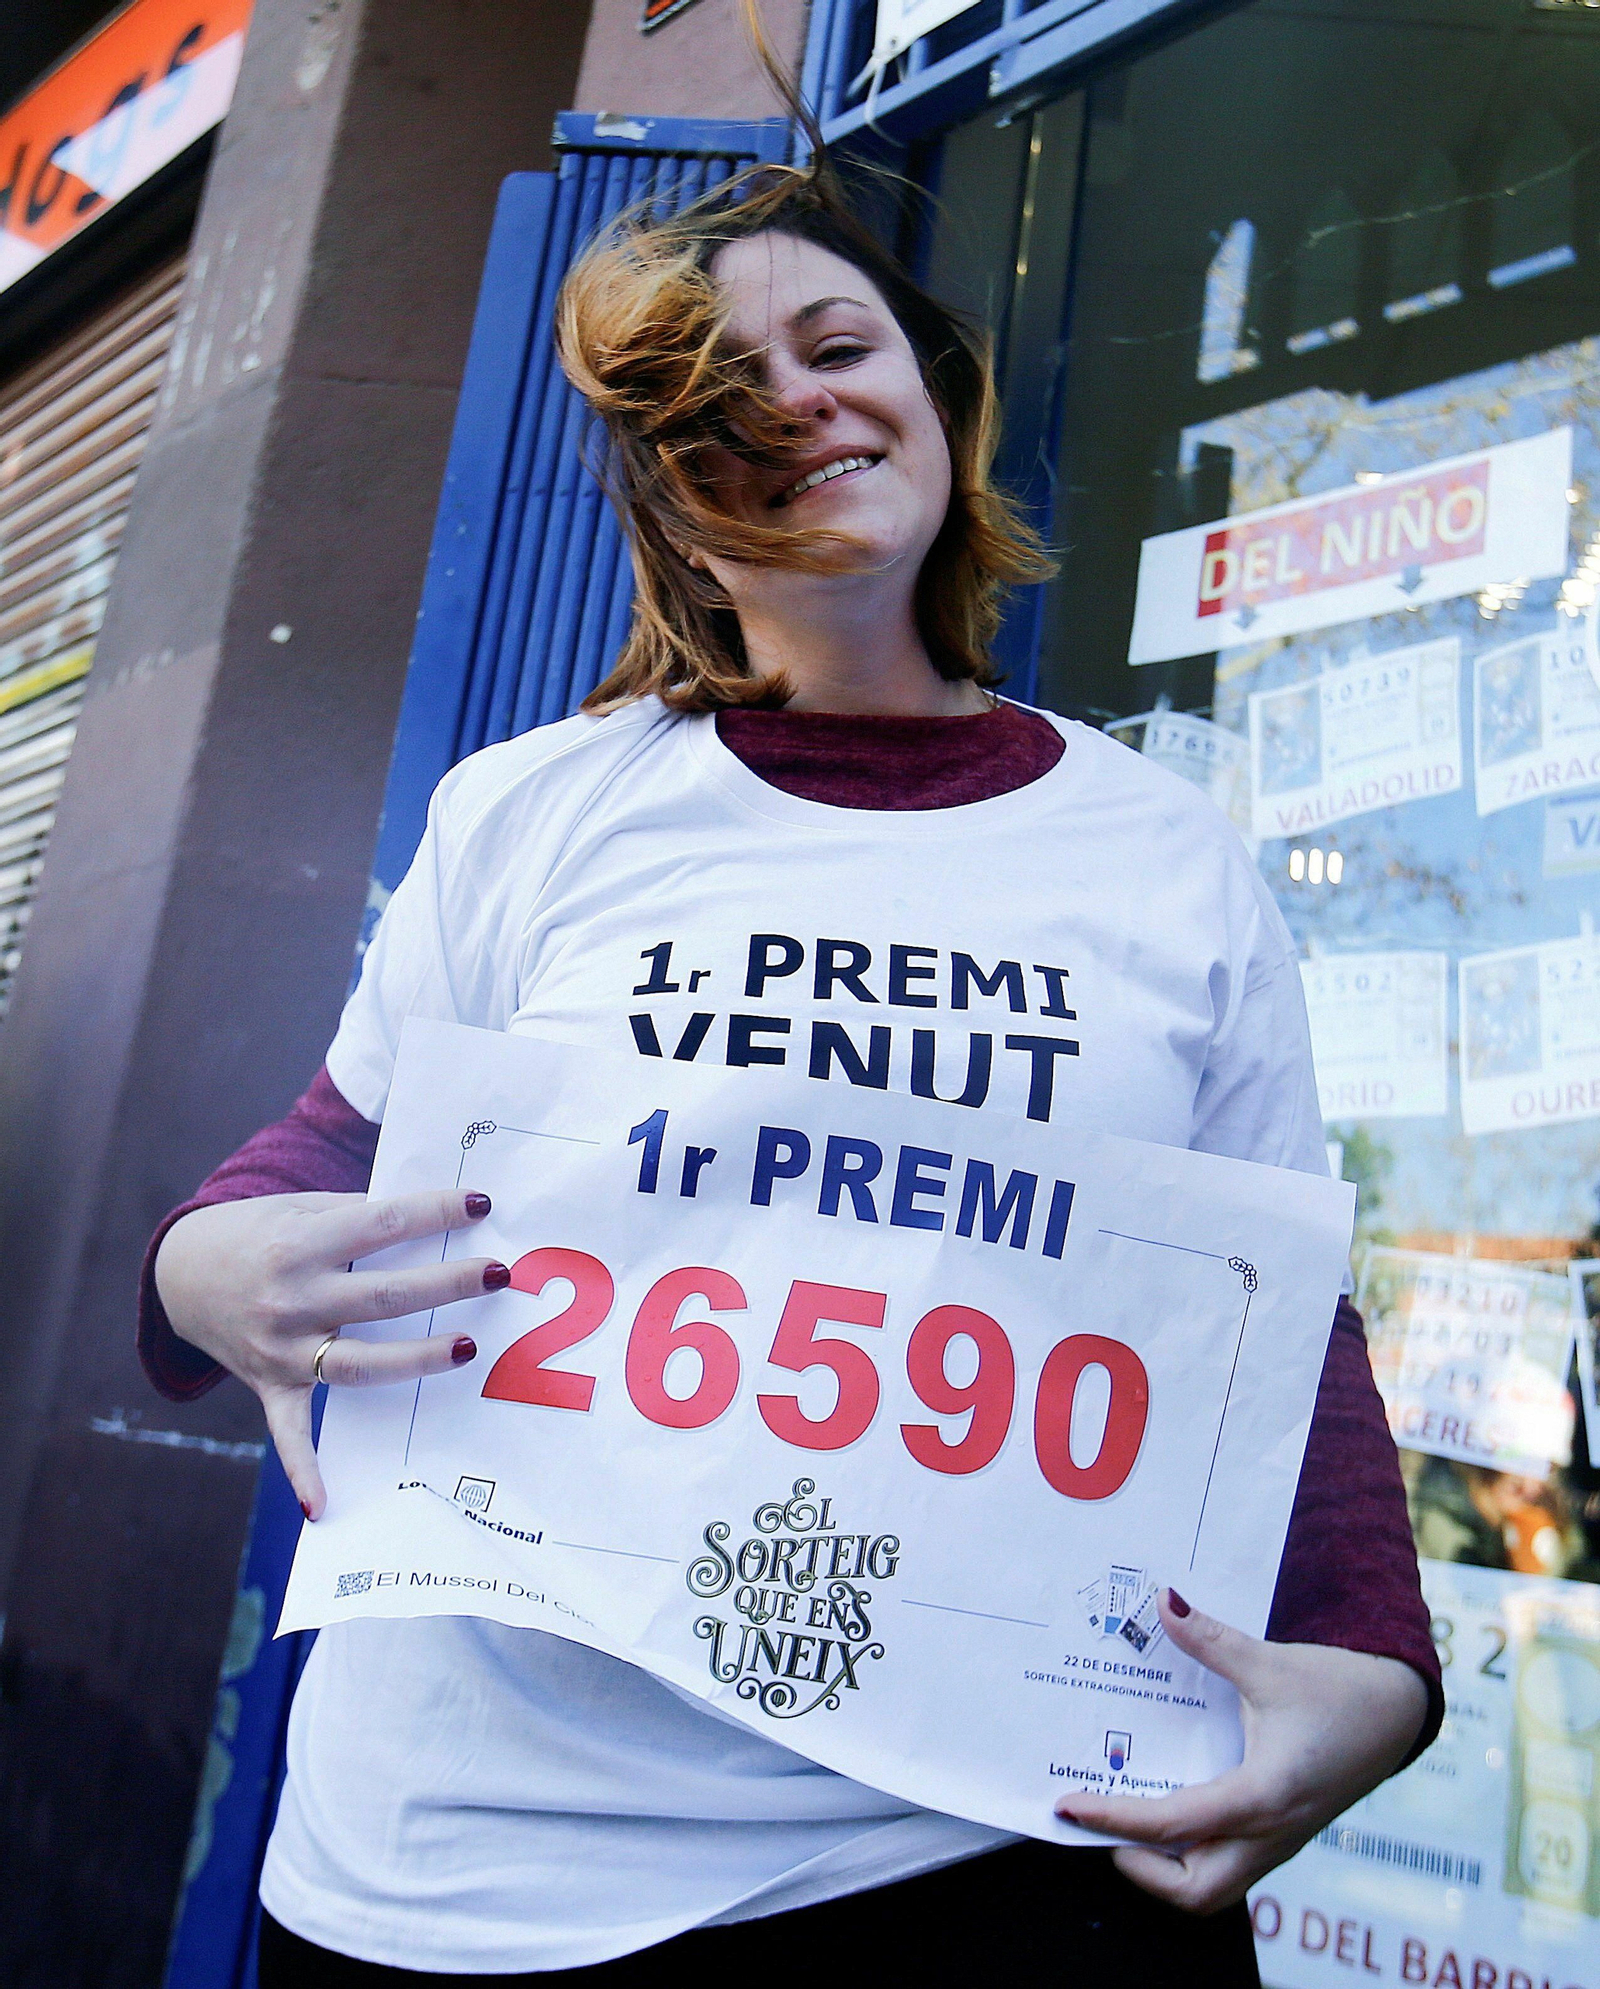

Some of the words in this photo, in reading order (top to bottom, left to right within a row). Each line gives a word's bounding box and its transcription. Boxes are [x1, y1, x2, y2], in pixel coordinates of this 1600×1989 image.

[1201, 537, 1303, 602] DEL
[1321, 485, 1485, 574] NIÑO
[1275, 763, 1455, 832] VALLADOLID
[632, 941, 711, 996] 1r
[744, 933, 1077, 1021] PREMI
[1319, 1080, 1395, 1110] DRID
[627, 1108, 718, 1199] 1r
[750, 1125, 1077, 1260] PREMI
[481, 1246, 1150, 1501] 26590
[1403, 1405, 1499, 1456] CERES
[464, 1509, 544, 1545] Nacional
[752, 1477, 837, 1534] EL
[376, 1571, 401, 1588] El
[409, 1572, 498, 1592] Mussol
[506, 1582, 546, 1604] Del
[686, 1521, 900, 1598] SORTEIG
[734, 1585, 799, 1625] QUE
[806, 1580, 872, 1642] ENS
[693, 1615, 885, 1715] UNEIX
[1023, 1670, 1068, 1686] SORTEIG
[1070, 1679, 1154, 1701] EXTRAORDINARI
[1155, 1692, 1169, 1704] DE
[1172, 1695, 1208, 1709] NADAL
[1063, 1655, 1079, 1667] 22
[1082, 1658, 1100, 1671] DE
[1103, 1661, 1173, 1683] DESEMBRE
[1049, 1763, 1104, 1782] Loterías
[1108, 1774, 1116, 1787] y
[1300, 1907, 1382, 1975] DEL
